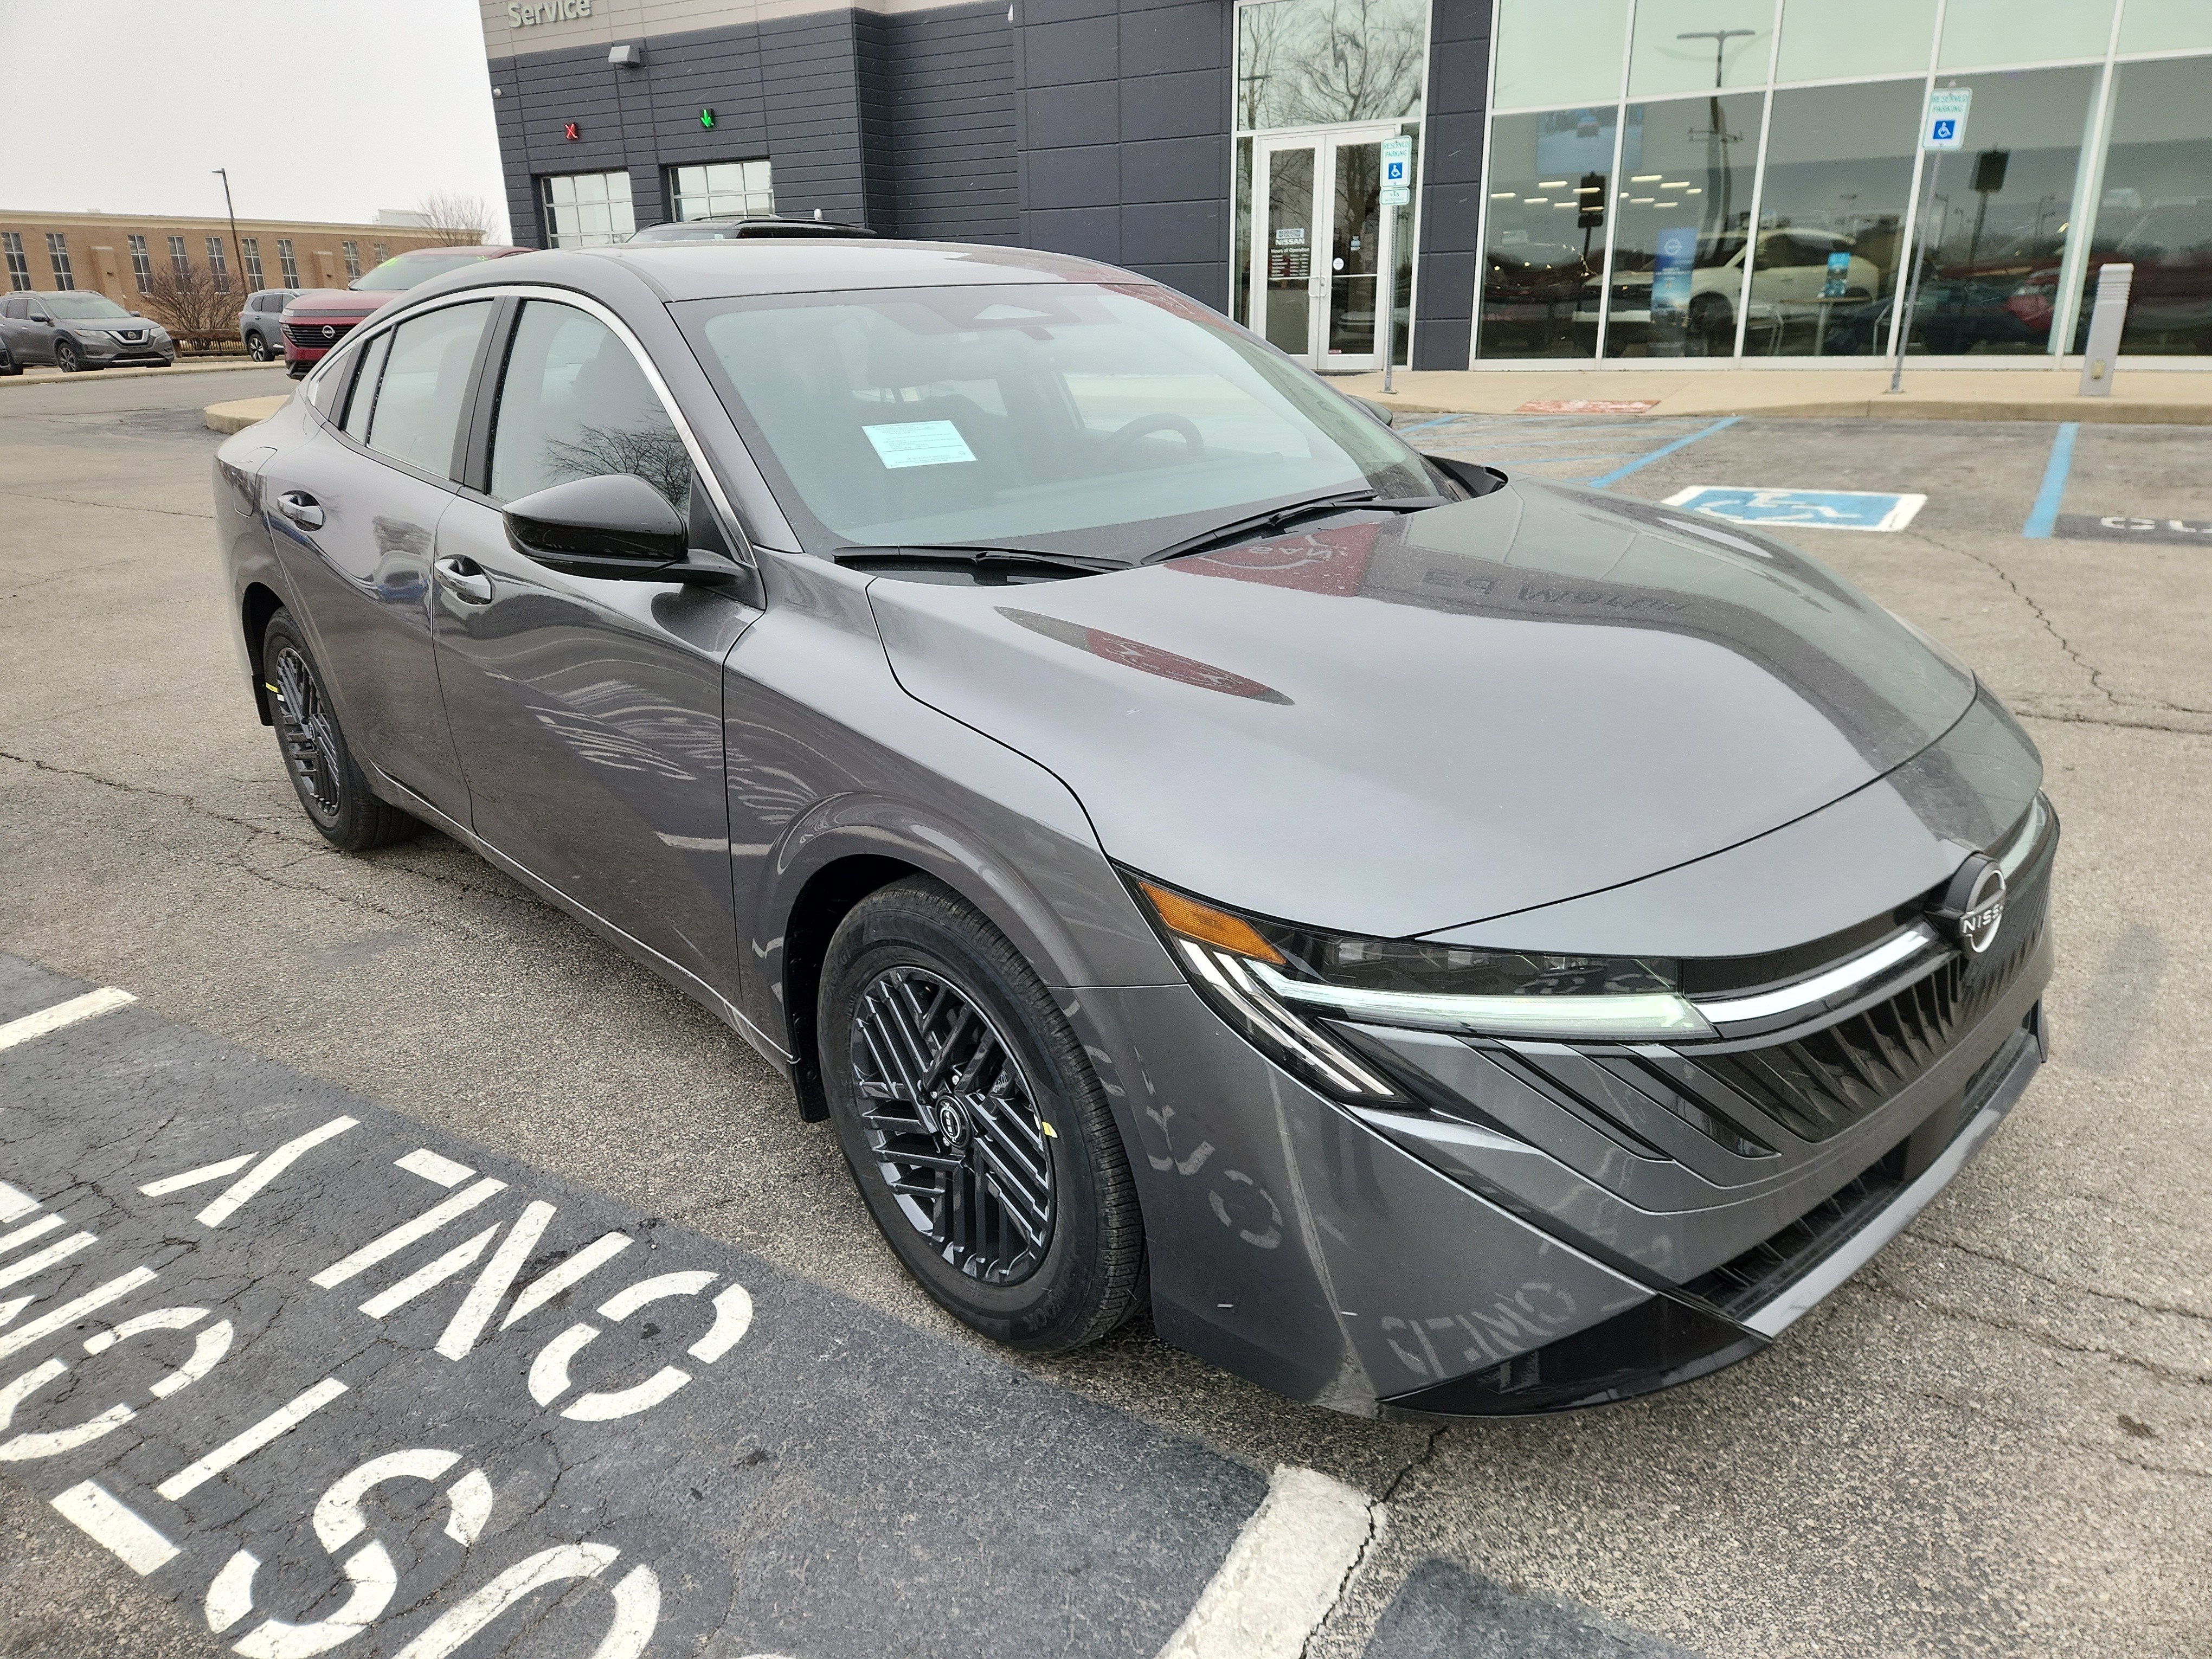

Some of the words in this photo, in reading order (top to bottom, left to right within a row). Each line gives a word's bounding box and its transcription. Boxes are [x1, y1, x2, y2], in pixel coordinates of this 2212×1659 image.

[507, 0, 592, 28] Service
[1931, 94, 1969, 102] RESERVED
[1932, 105, 1963, 113] PARKING
[1963, 903, 2004, 934] NISS
[138, 1115, 754, 1422] ONLY
